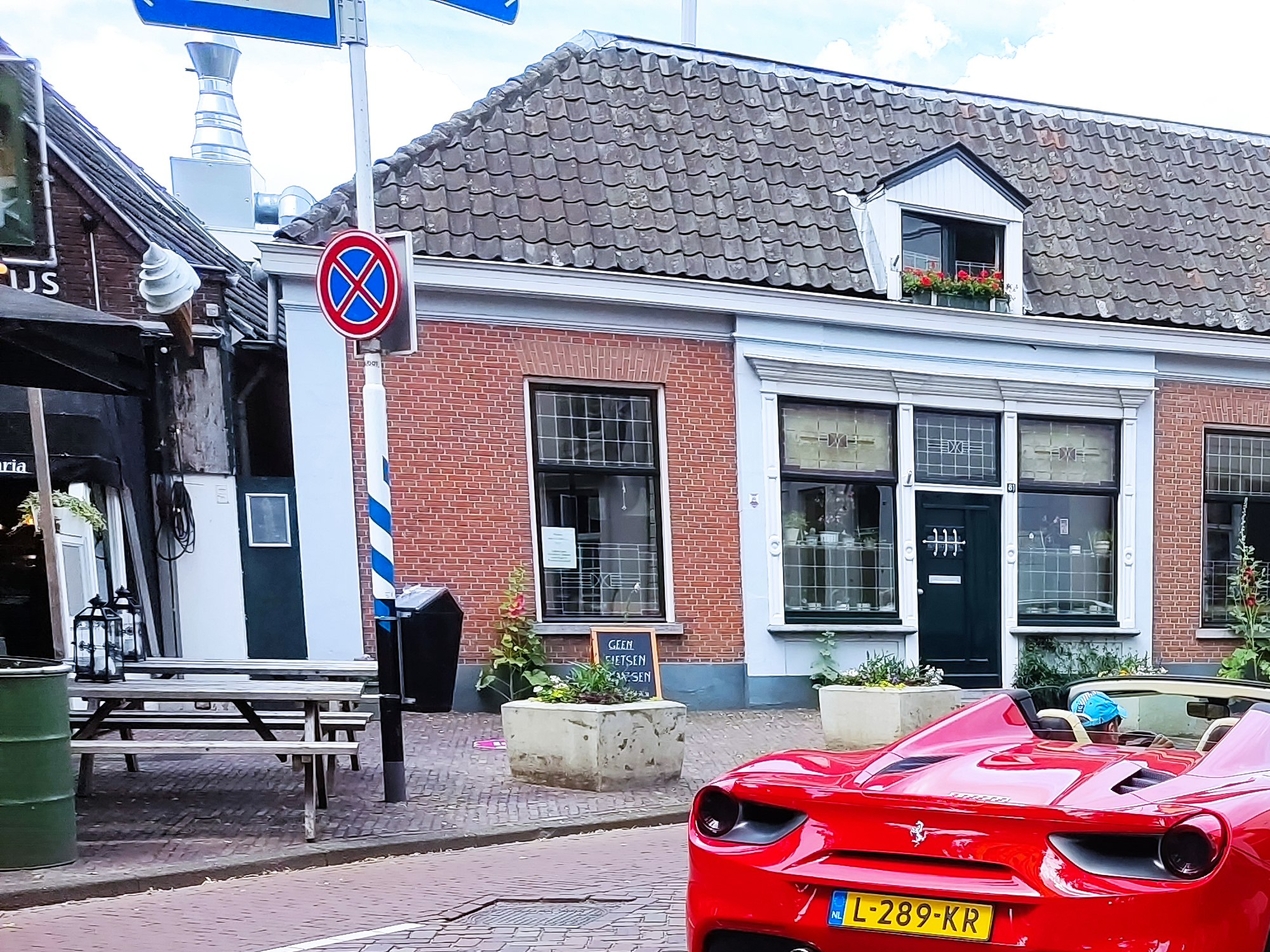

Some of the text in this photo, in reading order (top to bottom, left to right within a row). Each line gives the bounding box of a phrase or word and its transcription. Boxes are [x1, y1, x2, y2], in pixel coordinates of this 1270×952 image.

[0, 459, 28, 474] ria
[1007, 483, 1016, 493] 81
[608, 639, 634, 651] GEEN
[831, 897, 980, 934] NL L-289-KR
